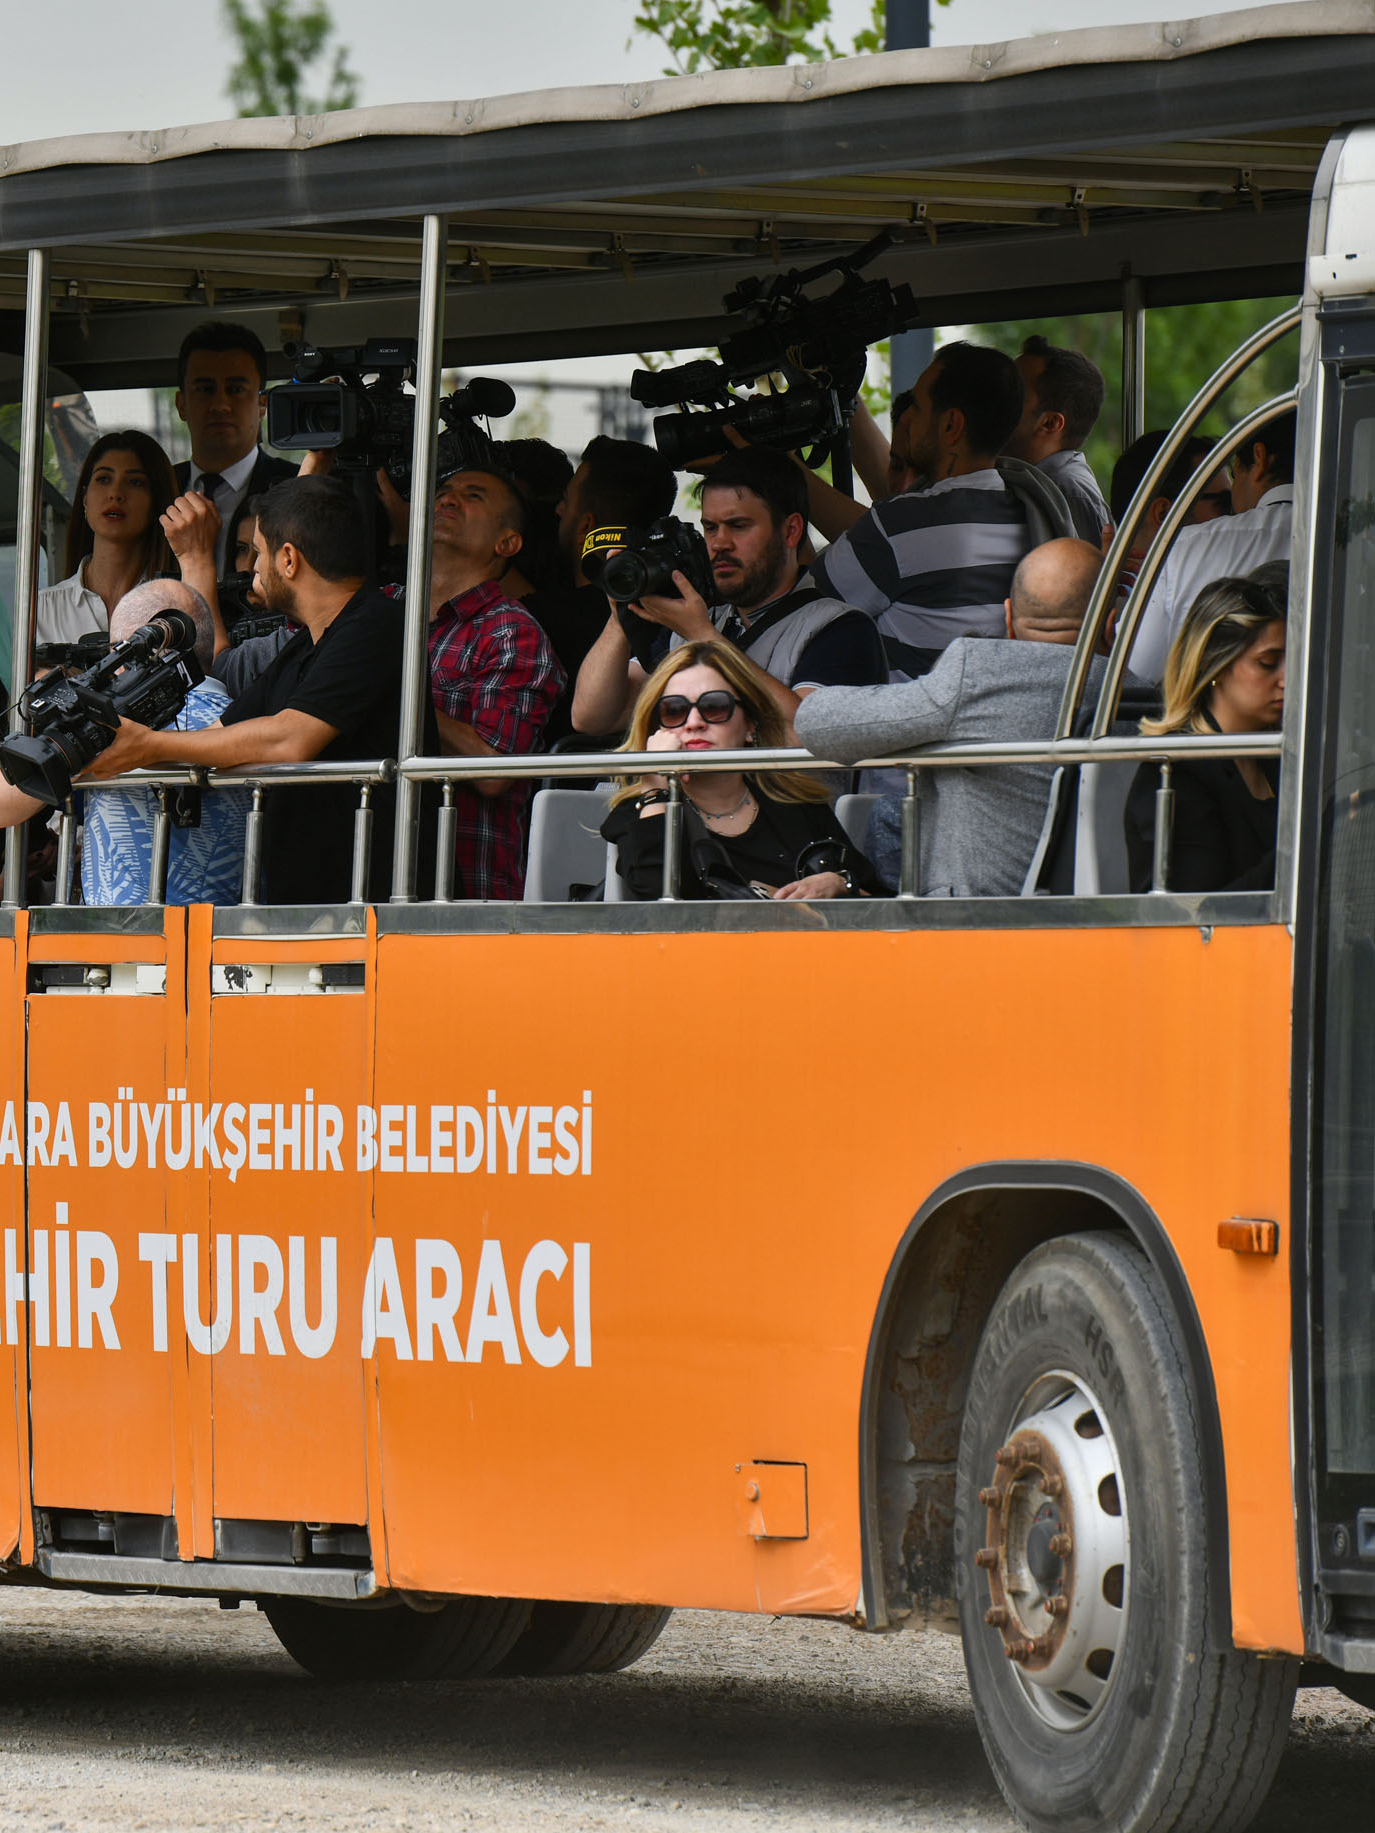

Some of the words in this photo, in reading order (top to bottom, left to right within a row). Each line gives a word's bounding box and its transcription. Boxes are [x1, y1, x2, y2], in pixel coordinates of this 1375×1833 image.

[595, 533, 622, 542] Nikon
[88, 1086, 344, 1183] BÜYÜKŞEHİR
[356, 1089, 592, 1176] BELEDİYESİ
[138, 1232, 338, 1359] TURU
[360, 1237, 592, 1368] ARACI
[1083, 1314, 1125, 1409] HSR
